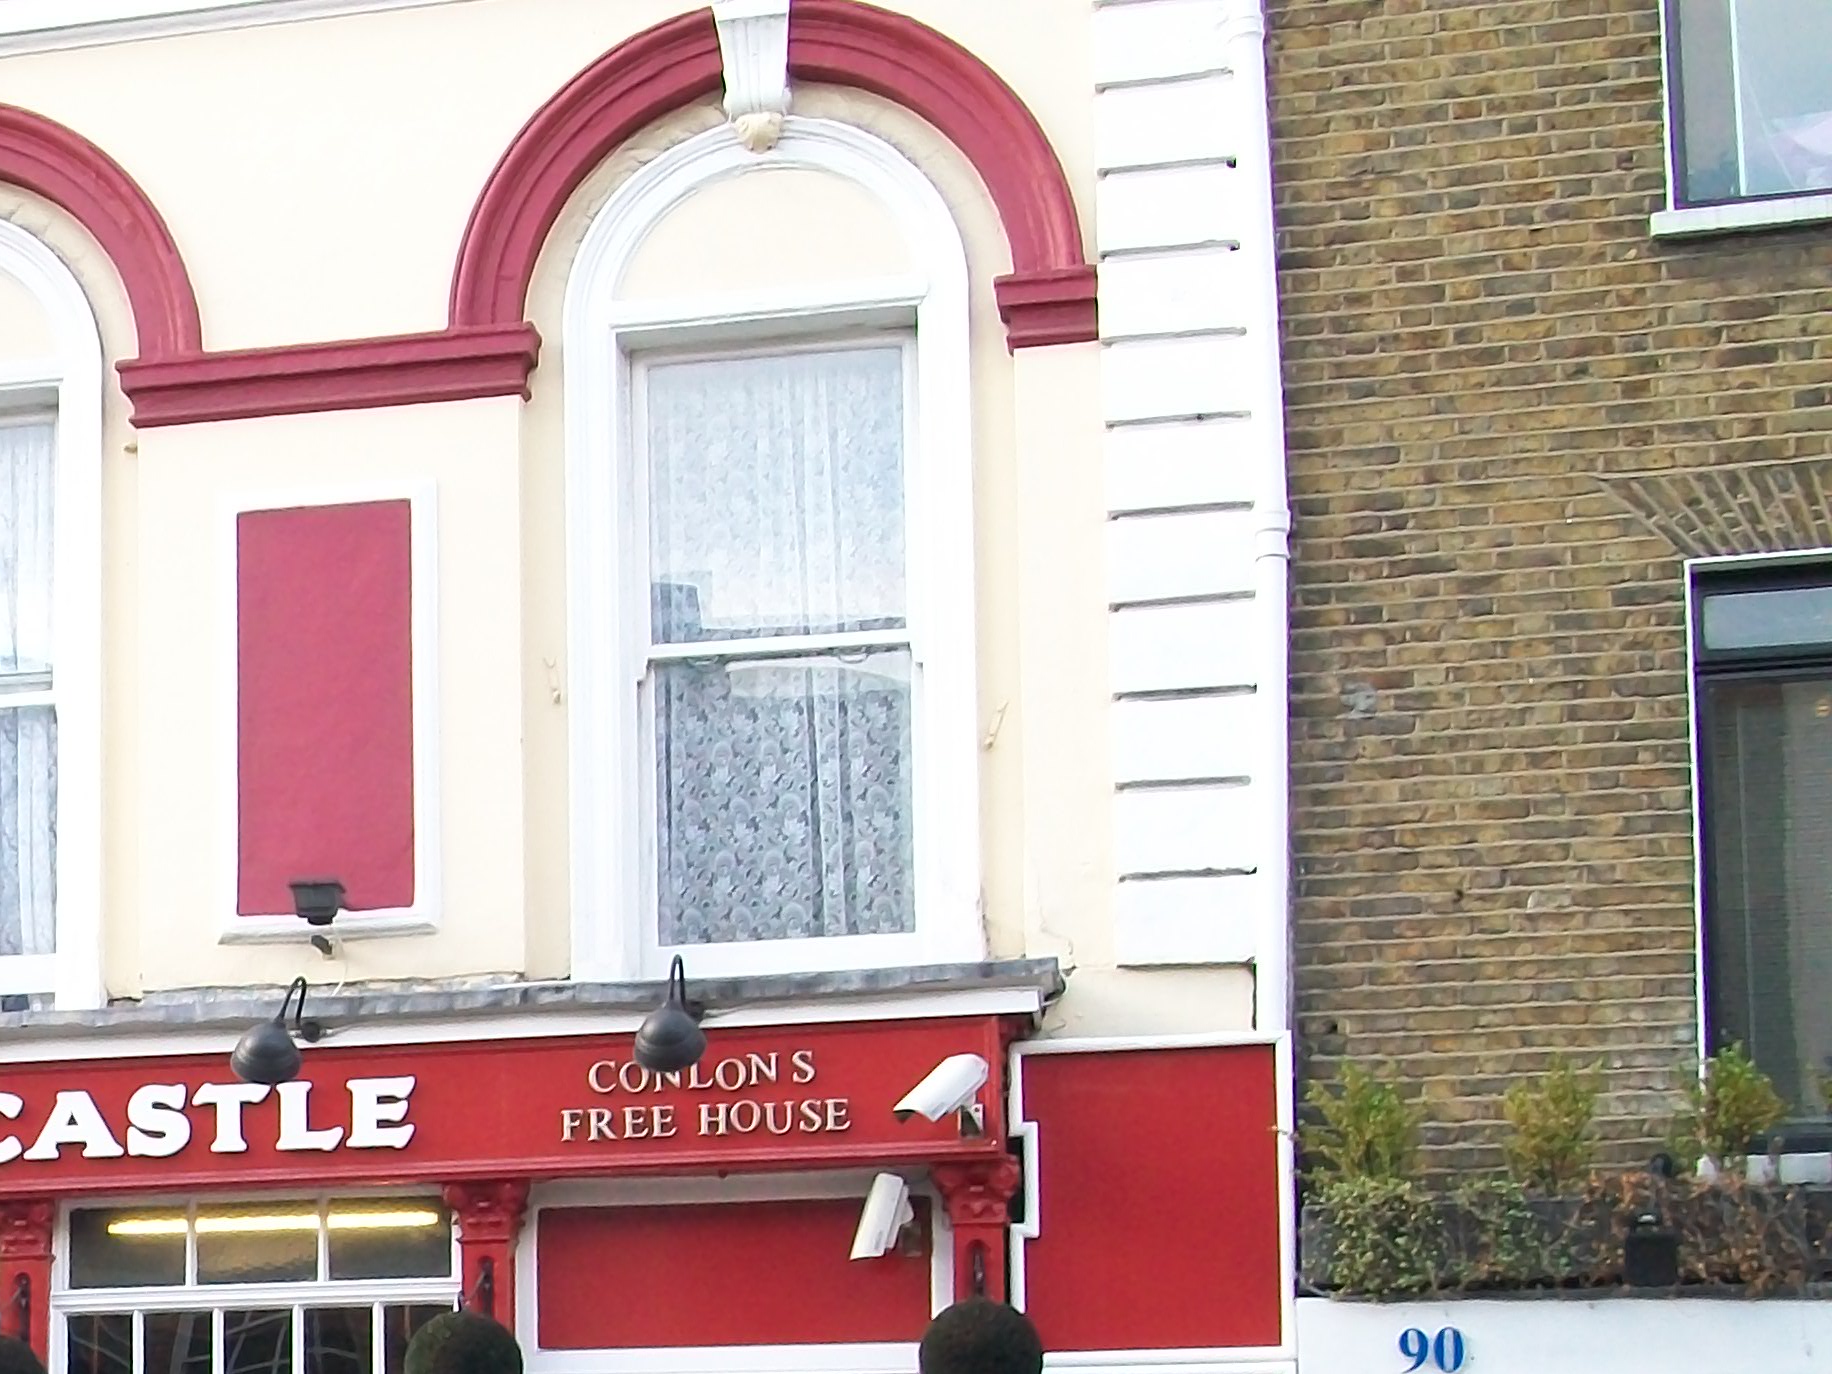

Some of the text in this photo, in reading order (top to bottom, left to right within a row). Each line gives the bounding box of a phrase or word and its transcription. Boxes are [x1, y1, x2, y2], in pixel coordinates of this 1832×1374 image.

[560, 1098, 851, 1142] FREE HOUSE
[1398, 1326, 1465, 1374] 90
